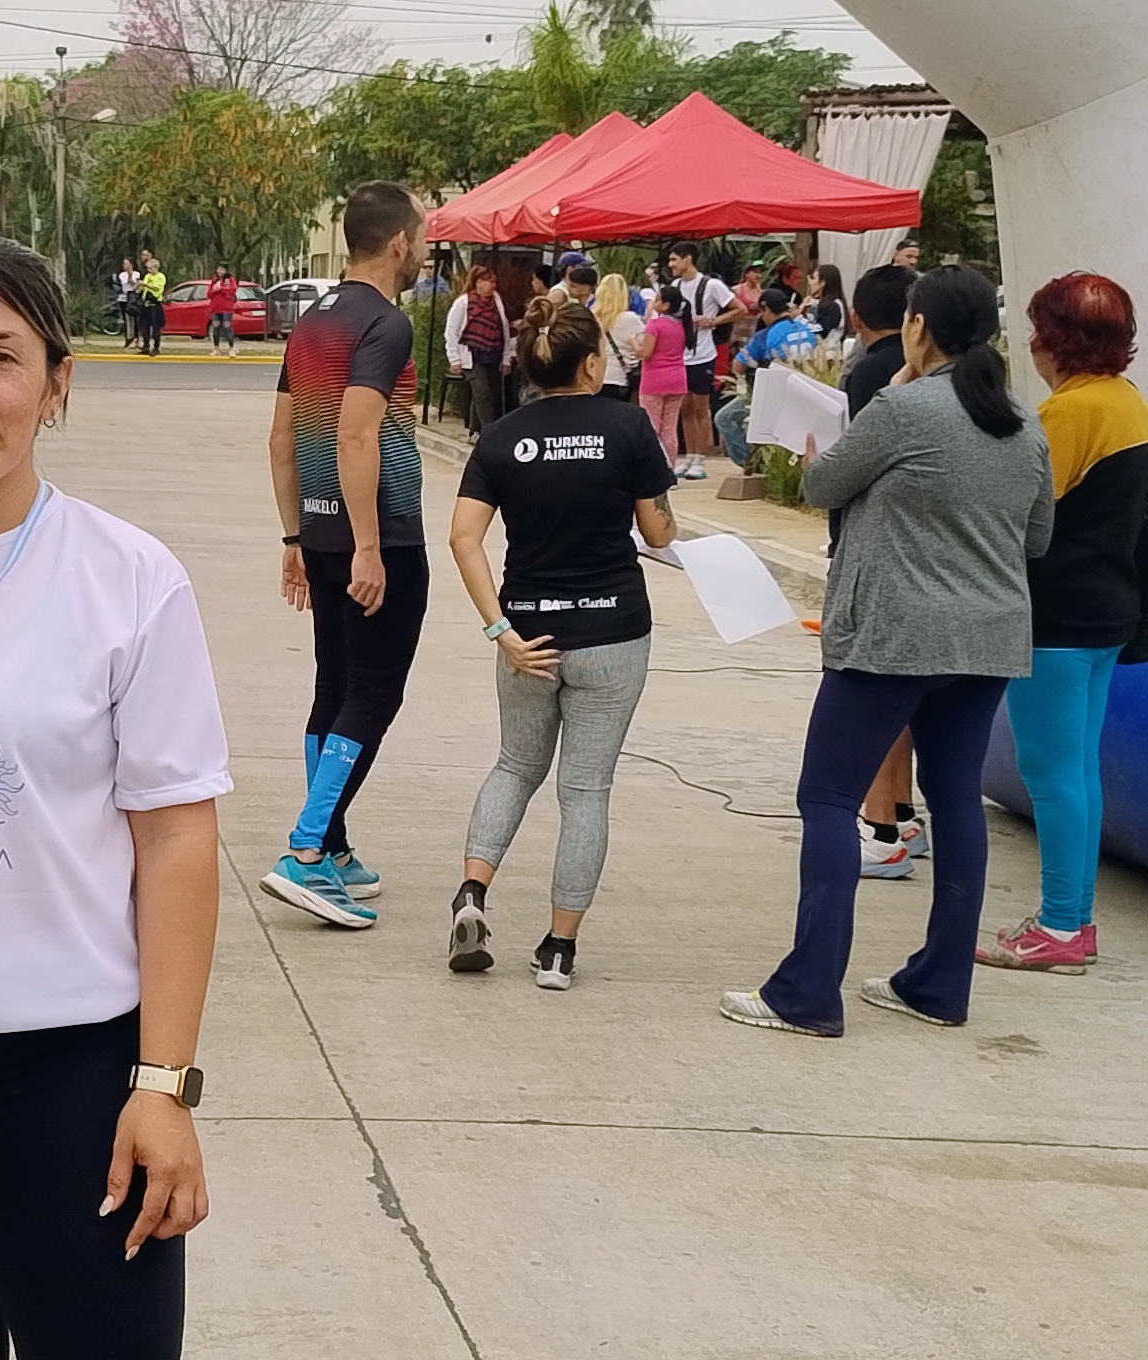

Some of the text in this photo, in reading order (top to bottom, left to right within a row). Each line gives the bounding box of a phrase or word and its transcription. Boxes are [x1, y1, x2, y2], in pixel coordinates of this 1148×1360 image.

[543, 434, 604, 448] TURKISH
[543, 447, 605, 461] AIRLINES
[304, 498, 339, 515] MARCELO
